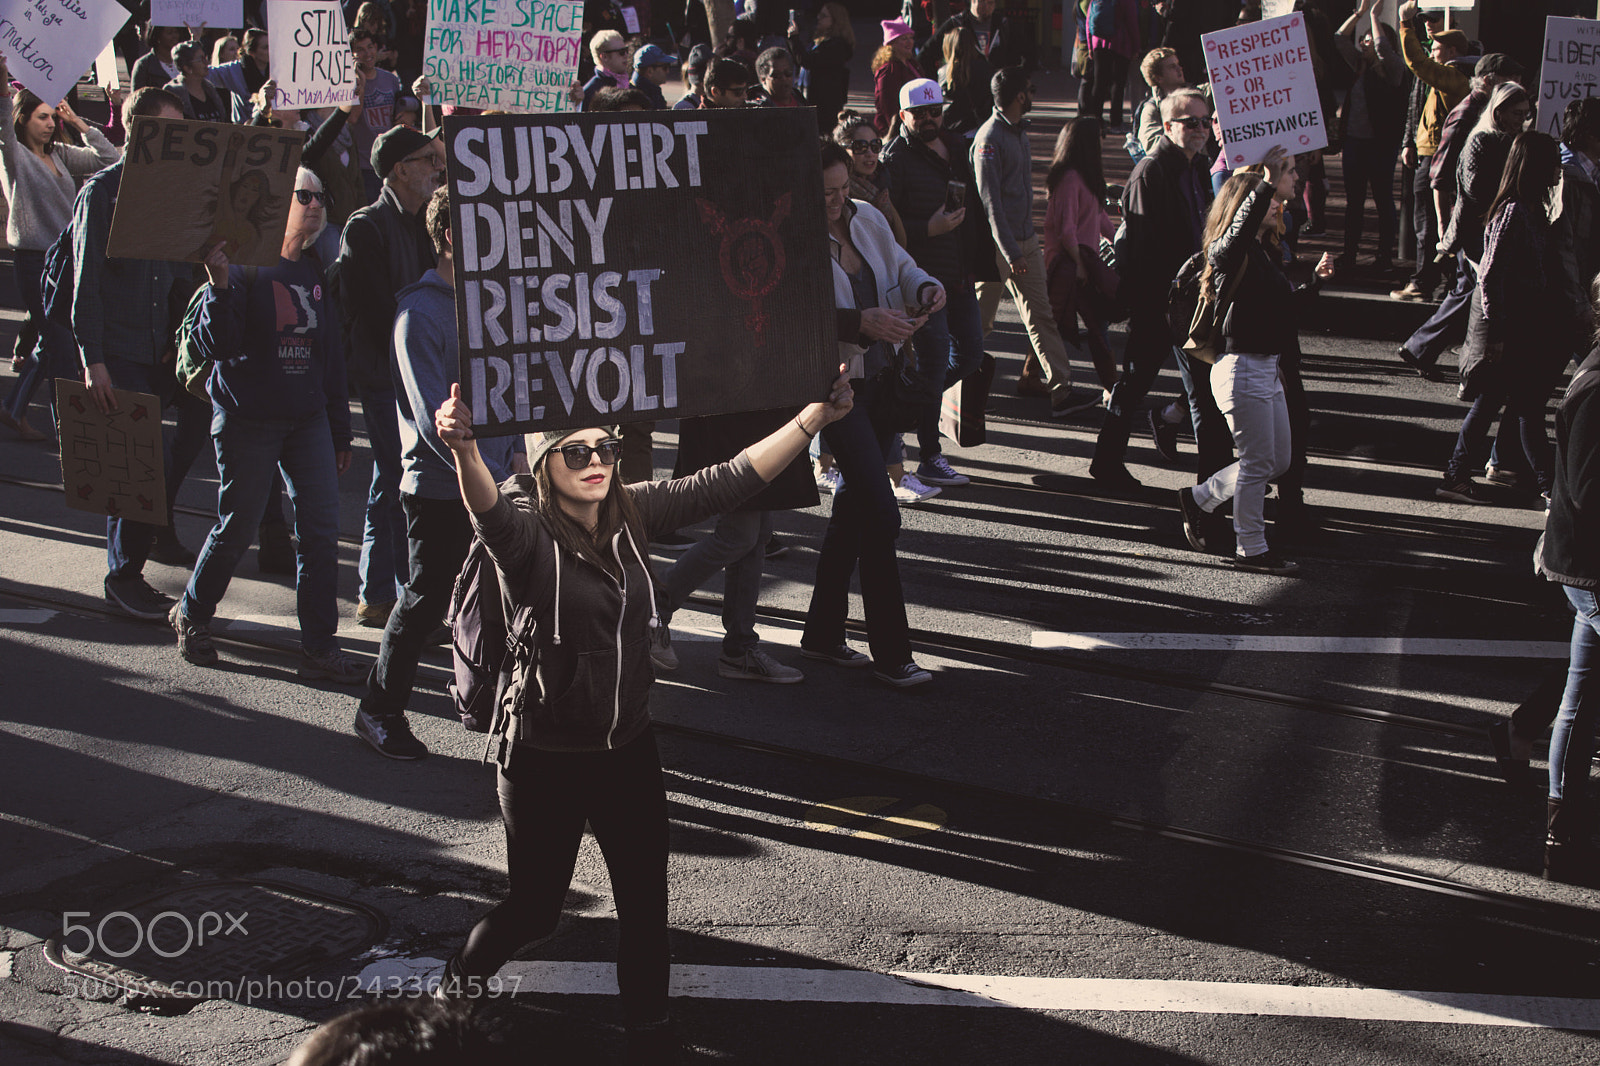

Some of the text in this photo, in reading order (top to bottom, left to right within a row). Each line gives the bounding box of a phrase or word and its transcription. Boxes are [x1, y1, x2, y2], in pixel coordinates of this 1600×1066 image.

[294, 10, 348, 46] STILL
[431, 0, 584, 32] MAKE SPACE
[429, 28, 581, 66] FOR HERSTORY
[1217, 25, 1291, 59] RESPECT
[291, 50, 353, 85] I RISE
[425, 56, 450, 81] SO
[459, 61, 525, 86] HISTORY
[1210, 46, 1308, 84] EXISTENCE
[1575, 71, 1597, 81] AND
[429, 82, 503, 105] REPEAT
[1229, 88, 1292, 115] EXPECT
[1244, 76, 1265, 93] OR
[1544, 80, 1597, 99] JUST
[1222, 110, 1319, 144] RESISTANCE
[453, 121, 708, 197] SUBVERT
[460, 197, 613, 272] DENY
[464, 268, 661, 349] RESIST
[278, 346, 311, 359] MARCH
[470, 342, 686, 425] REVOLT
[72, 420, 102, 477] HER
[105, 411, 131, 496] WITH
